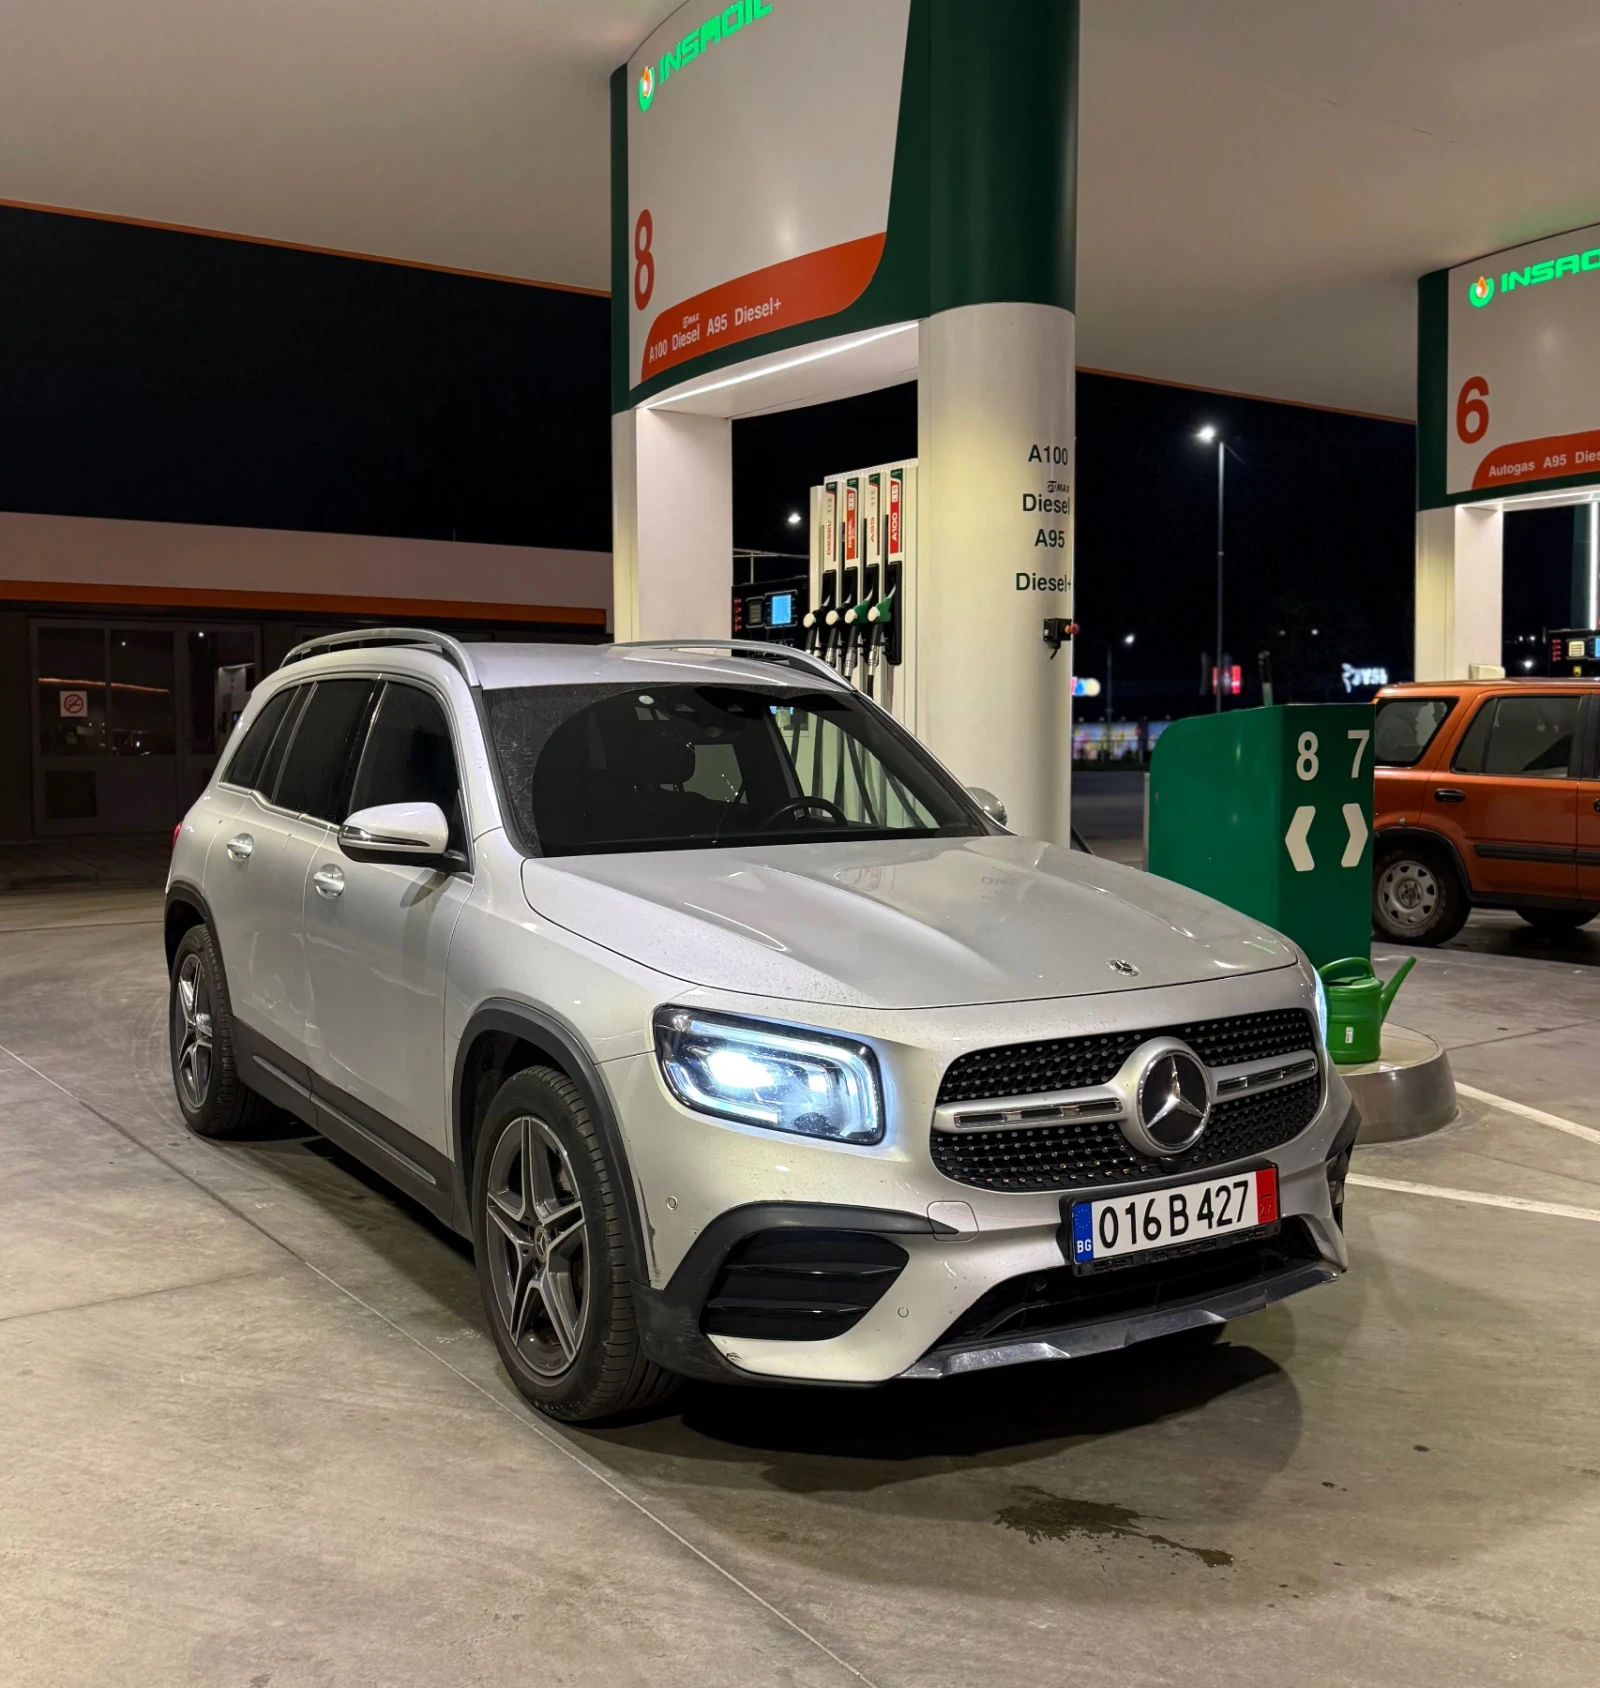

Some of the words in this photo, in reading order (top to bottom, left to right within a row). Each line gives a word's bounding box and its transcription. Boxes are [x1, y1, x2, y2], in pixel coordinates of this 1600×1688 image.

[658, 0, 773, 84] INSAOIL
[634, 208, 655, 311] 8
[649, 339, 668, 363] A100
[671, 323, 700, 351] Diesel
[706, 313, 728, 336] A95
[734, 296, 782, 326] Diesel+
[1456, 375, 1490, 444] 6
[1028, 444, 1068, 466] A100
[1488, 460, 1535, 477] Autogas
[1543, 453, 1568, 469] A95
[1022, 493, 1070, 515] Diesel
[1034, 528, 1065, 548] A95
[1015, 572, 1071, 592] Diesel+
[1296, 731, 1319, 781] 8
[1347, 729, 1370, 778] 7
[1076, 1238, 1092, 1253] BG
